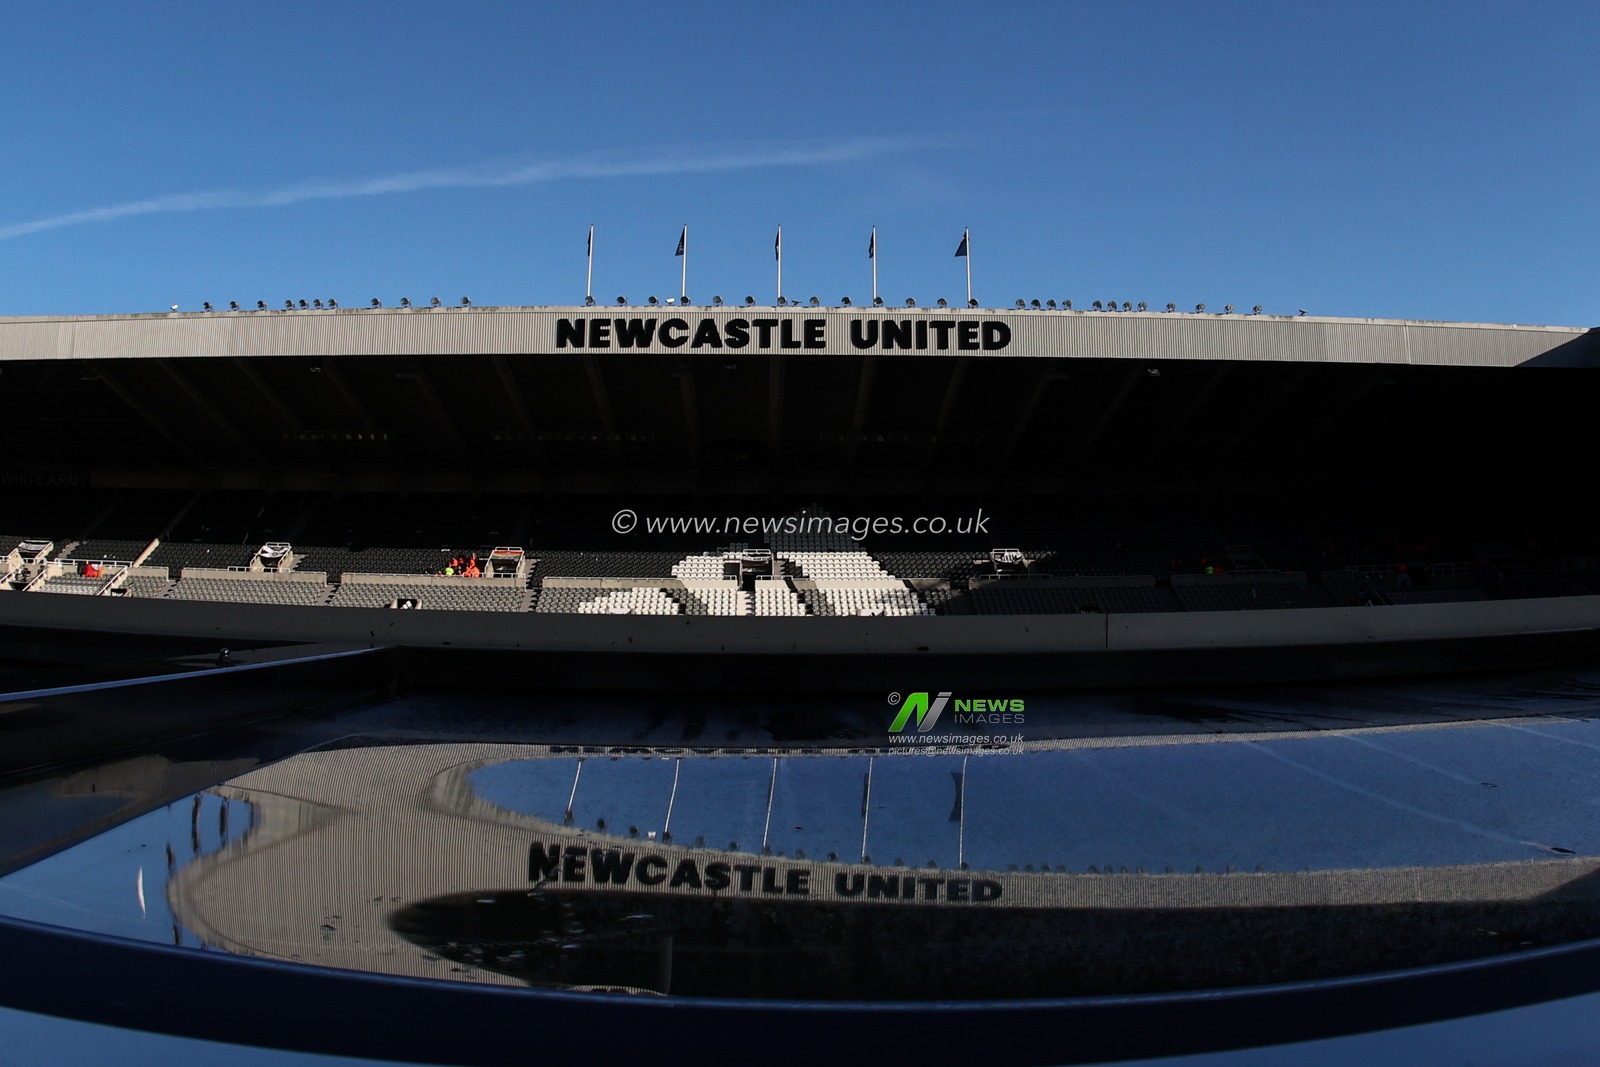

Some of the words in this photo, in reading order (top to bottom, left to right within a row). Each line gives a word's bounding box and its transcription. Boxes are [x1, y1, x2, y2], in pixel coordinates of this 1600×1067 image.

[556, 318, 826, 349] NEWCASTLE
[851, 320, 1011, 351] UNITED
[0, 471, 46, 486] WHITE
[47, 471, 89, 488] ARMY
[528, 842, 810, 895] NEWCASTLE
[835, 872, 1003, 901] UNITED
